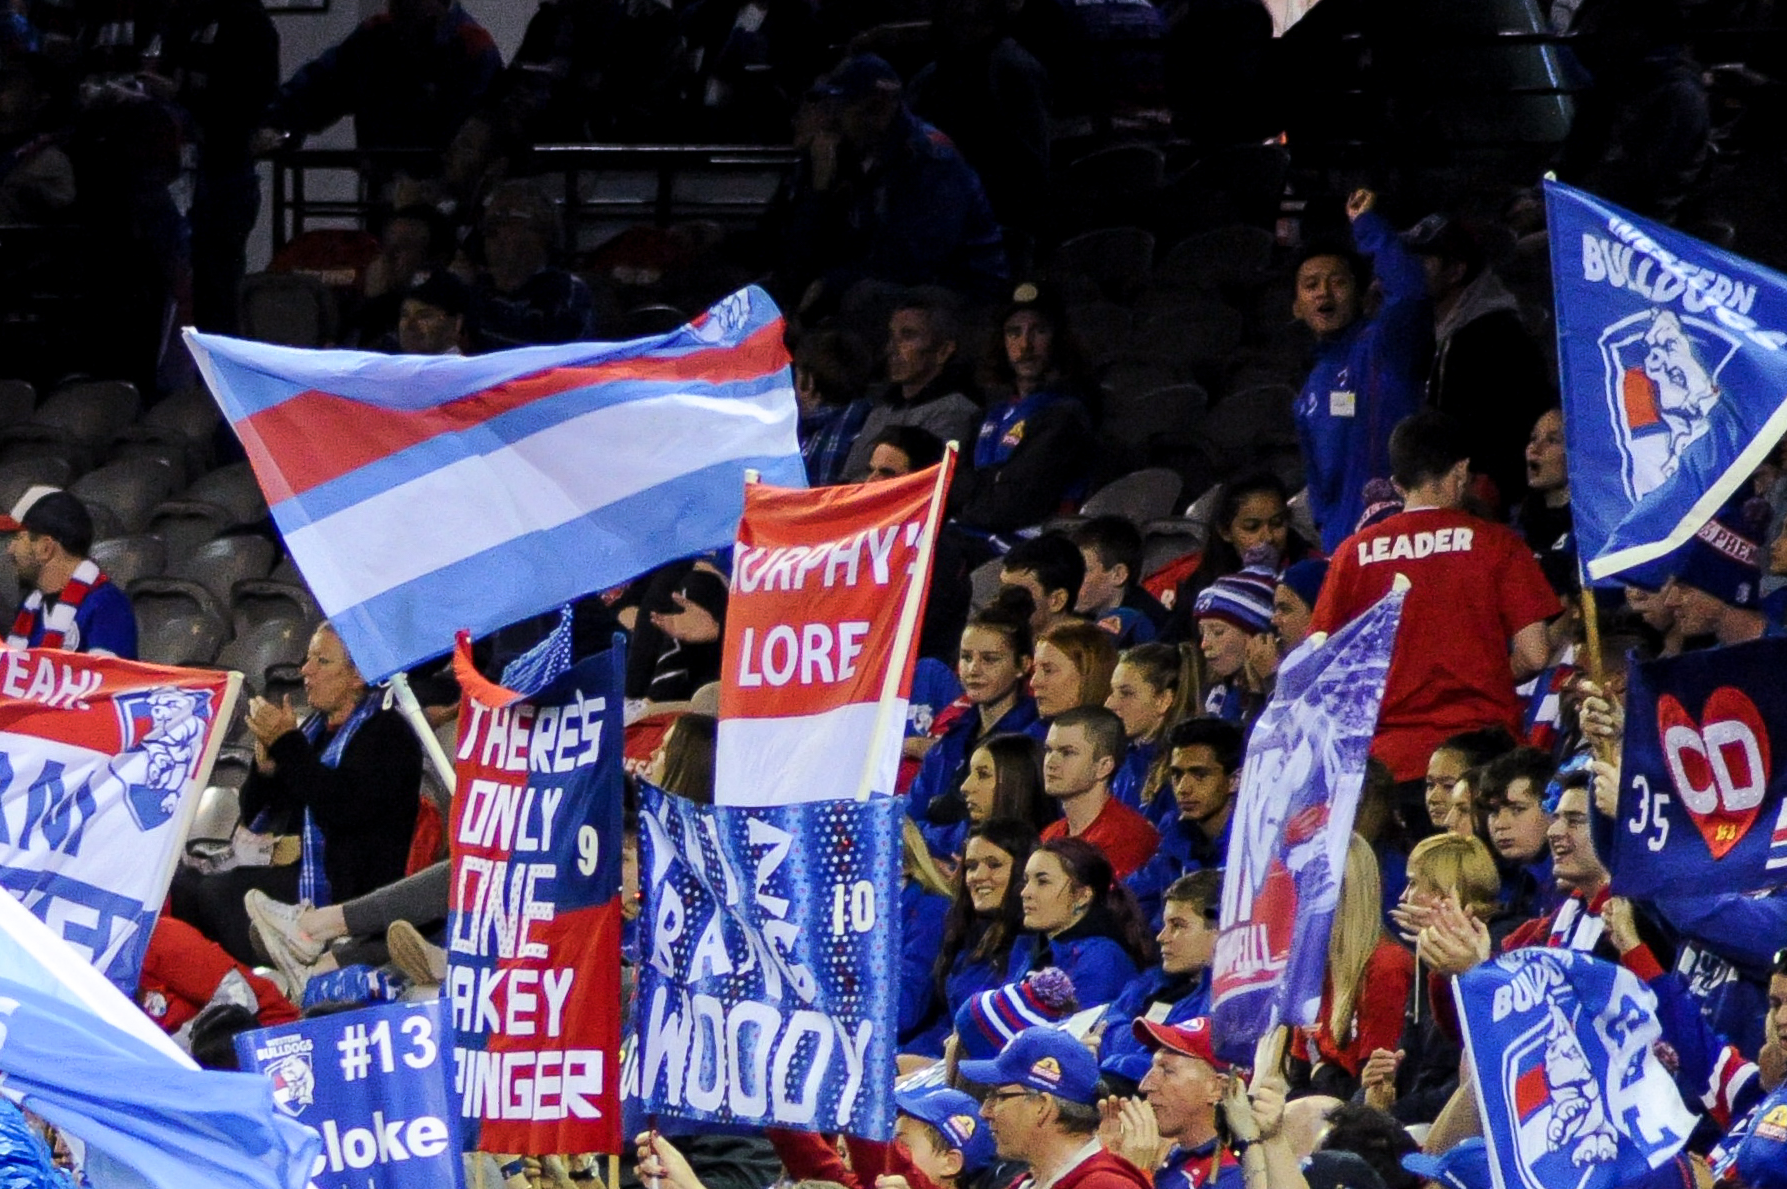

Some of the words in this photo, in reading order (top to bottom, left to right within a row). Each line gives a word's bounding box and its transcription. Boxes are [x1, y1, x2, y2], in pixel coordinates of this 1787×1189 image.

[1357, 528, 1474, 567] LEADER
[738, 621, 870, 687] LORE
[457, 688, 607, 774] THERE'S
[1664, 719, 1767, 815] CD
[458, 779, 563, 852] ONLY
[1628, 774, 1671, 852] 35
[577, 824, 600, 877] 9
[450, 854, 559, 960] ONE
[833, 880, 875, 936] 10
[257, 1039, 314, 1061] BULLDOGS
[337, 1015, 437, 1082] #13
[642, 985, 873, 1127] WOODY
